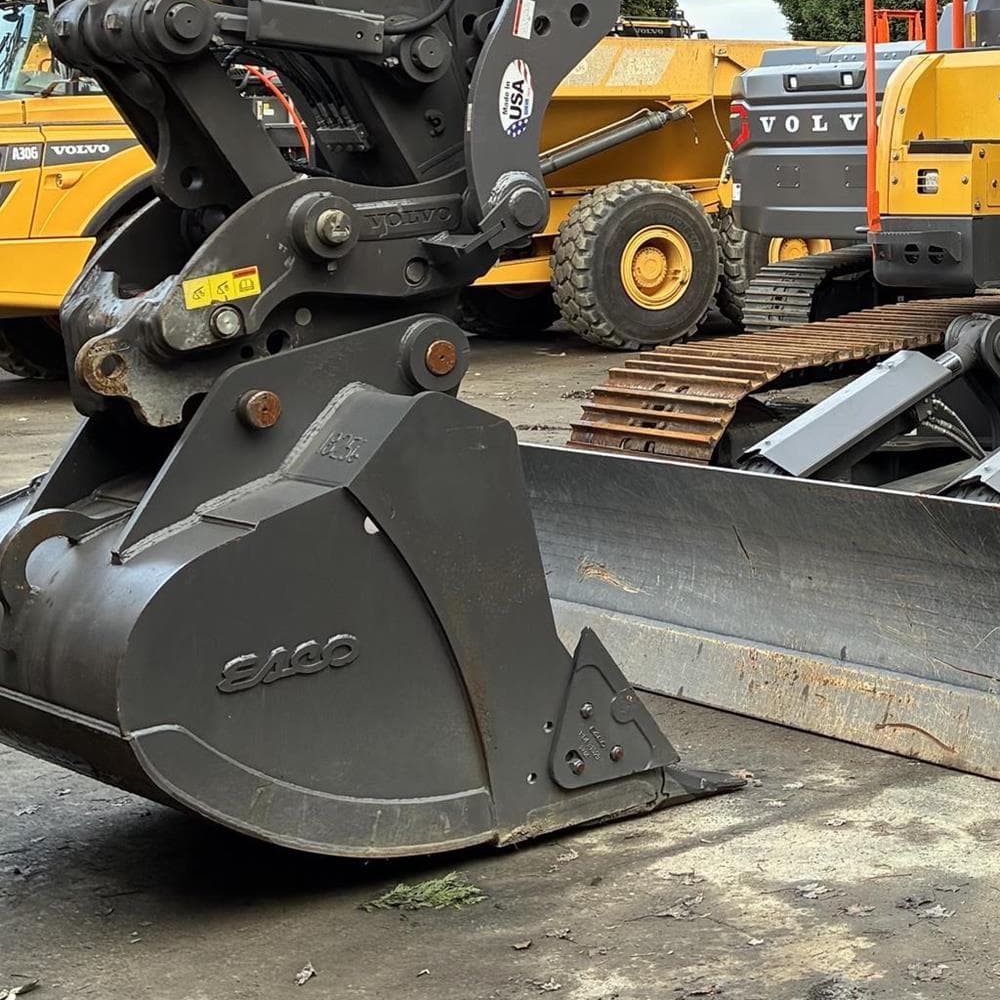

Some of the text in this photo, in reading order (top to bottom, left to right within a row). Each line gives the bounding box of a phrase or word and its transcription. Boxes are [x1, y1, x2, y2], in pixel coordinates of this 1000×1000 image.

[509, 79, 524, 120] USA
[760, 113, 881, 133] VOLV
[51, 144, 110, 155] VOLVO
[364, 207, 453, 229] VOLVO
